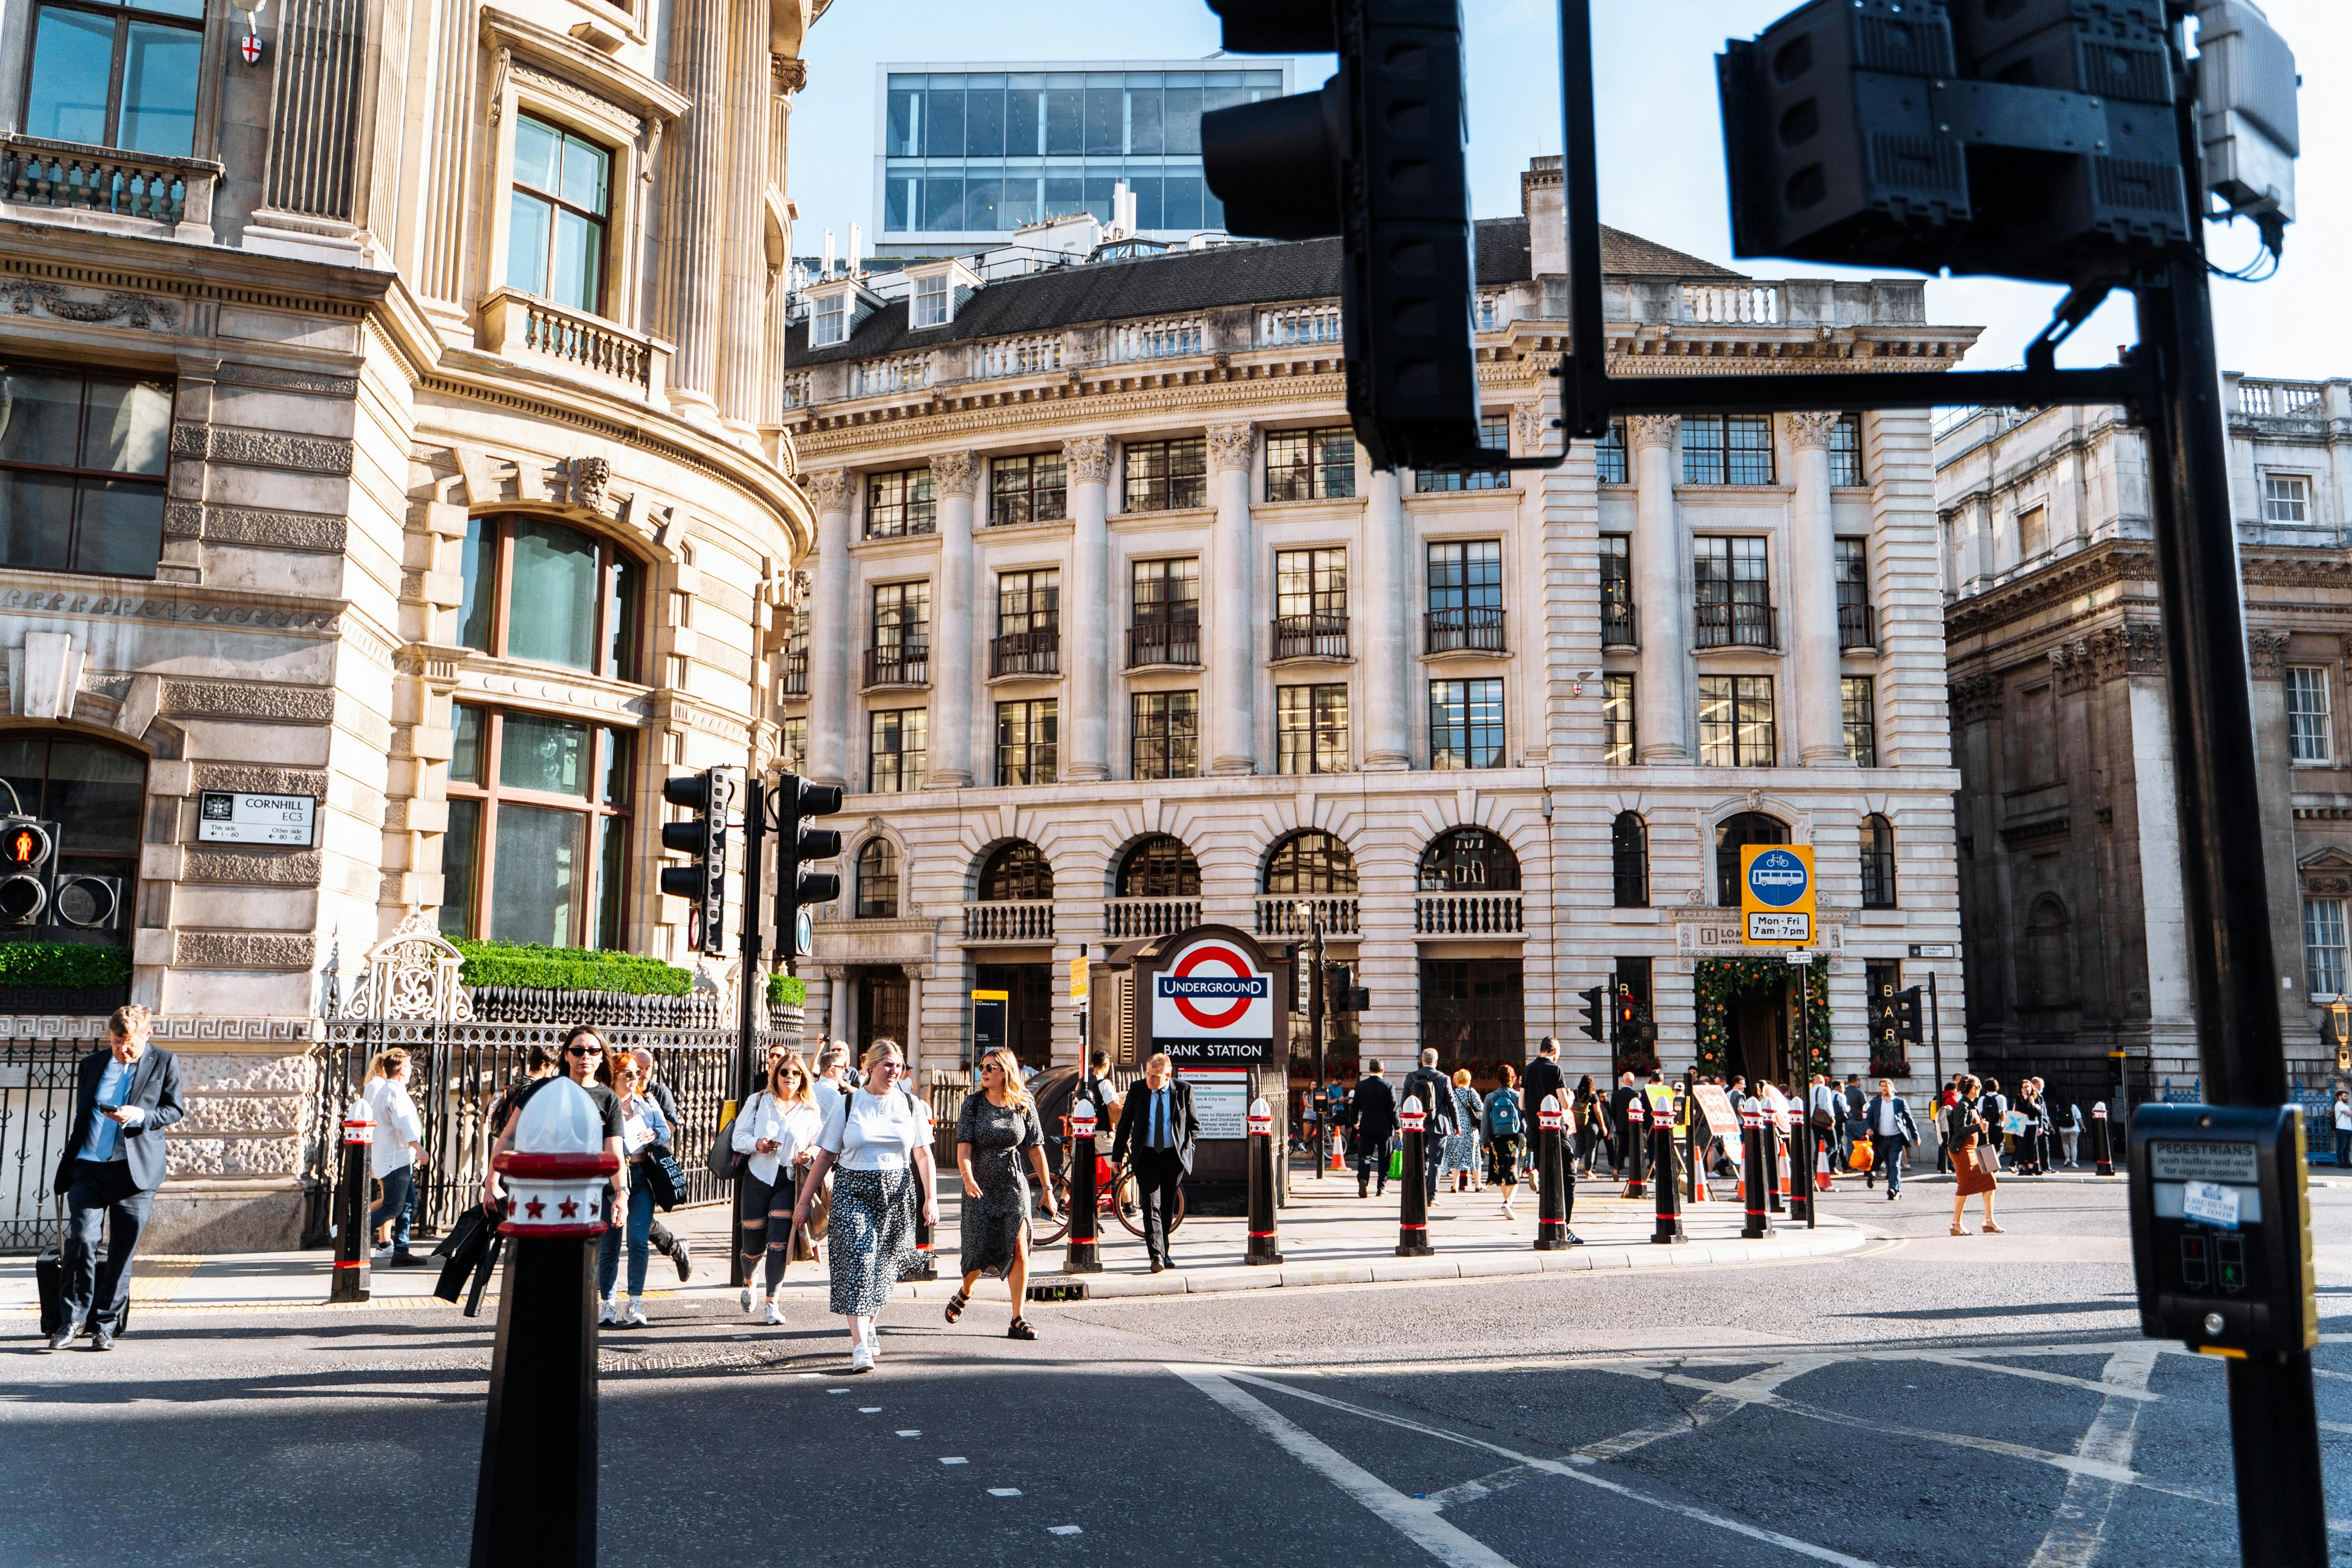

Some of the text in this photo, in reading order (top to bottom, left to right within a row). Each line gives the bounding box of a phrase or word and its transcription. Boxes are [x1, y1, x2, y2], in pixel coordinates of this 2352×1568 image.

[246, 799, 303, 810] CORNHILL
[282, 812, 302, 821] EC3
[1884, 985, 1894, 1040] BAR
[1164, 1044, 1262, 1056] BANK STATION
[2157, 1143, 2252, 1156] PEDESTRIANS
[2157, 1156, 2179, 1165] push
[2181, 1156, 2211, 1166] button
[2178, 1167, 2205, 1176] signal
[2208, 1169, 2248, 1177] opposite
